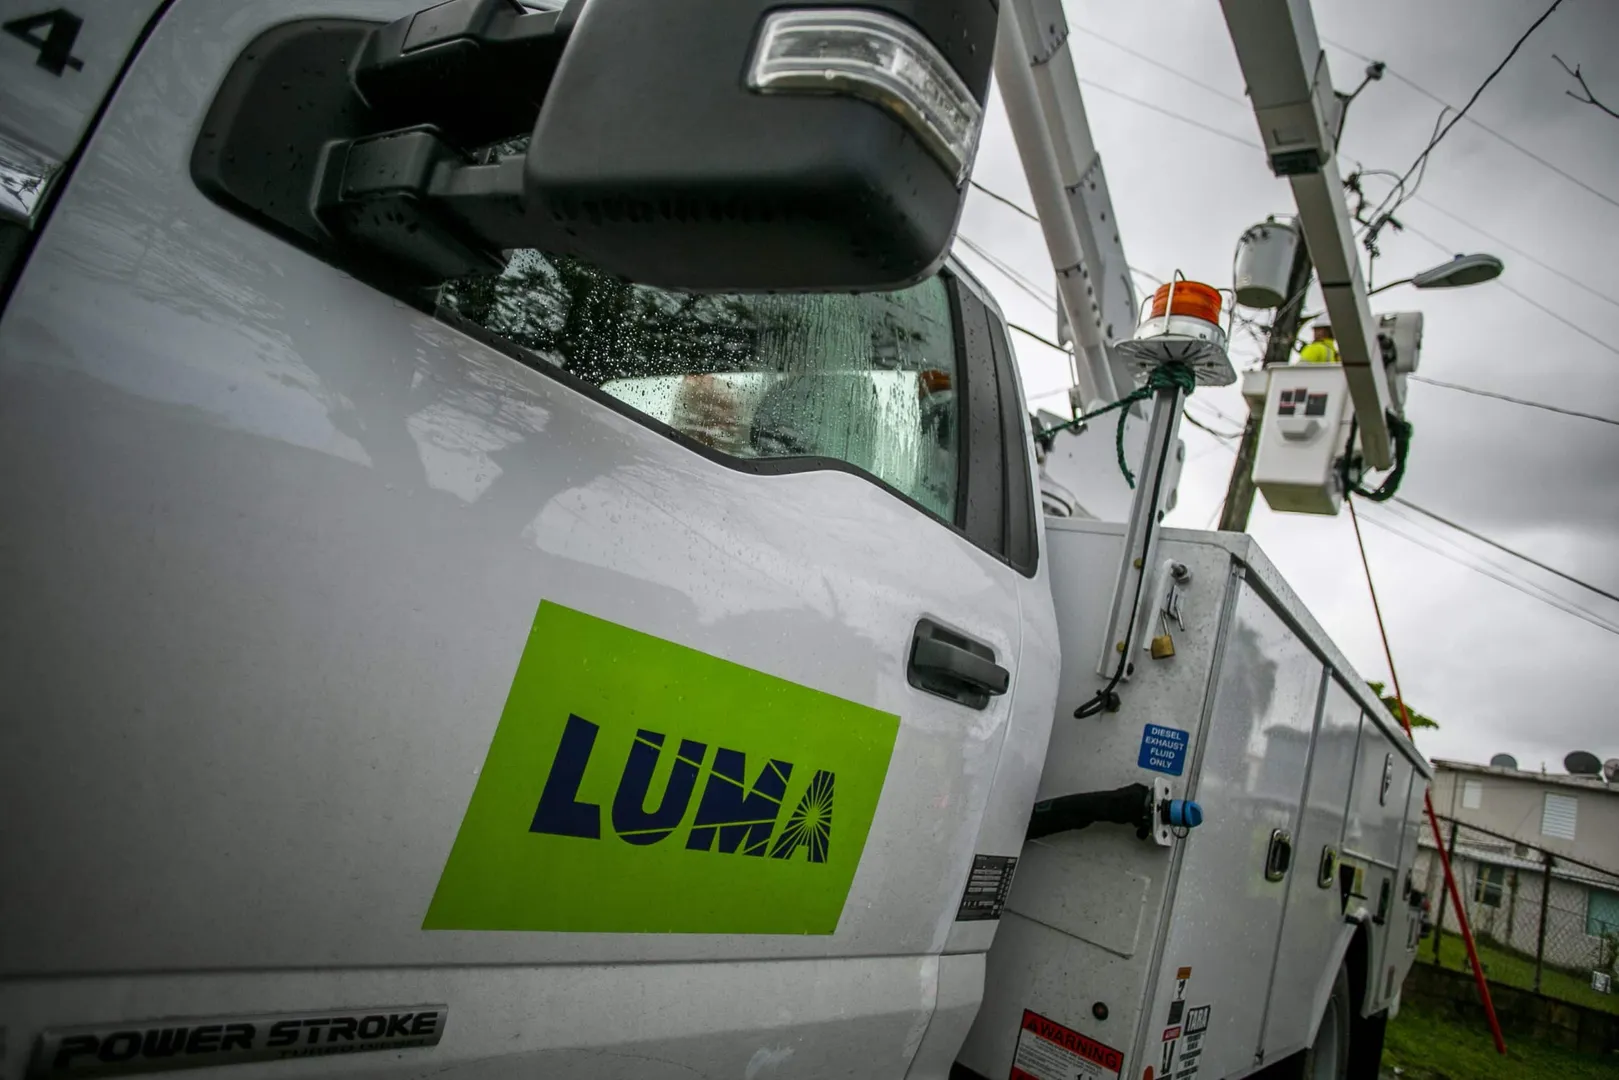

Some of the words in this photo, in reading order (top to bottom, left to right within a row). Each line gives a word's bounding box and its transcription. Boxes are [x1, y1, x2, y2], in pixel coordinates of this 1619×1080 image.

[2, 8, 84, 78] 4
[1145, 736, 1184, 751] EXHAUST
[1152, 727, 1181, 740] DIESEL
[1149, 757, 1172, 769] ONLY
[1150, 747, 1175, 759] FLUID
[528, 713, 836, 864] LUMA
[52, 1023, 256, 1069] POWER
[266, 1011, 439, 1047] STROKE
[1040, 1021, 1118, 1069] WARNING
